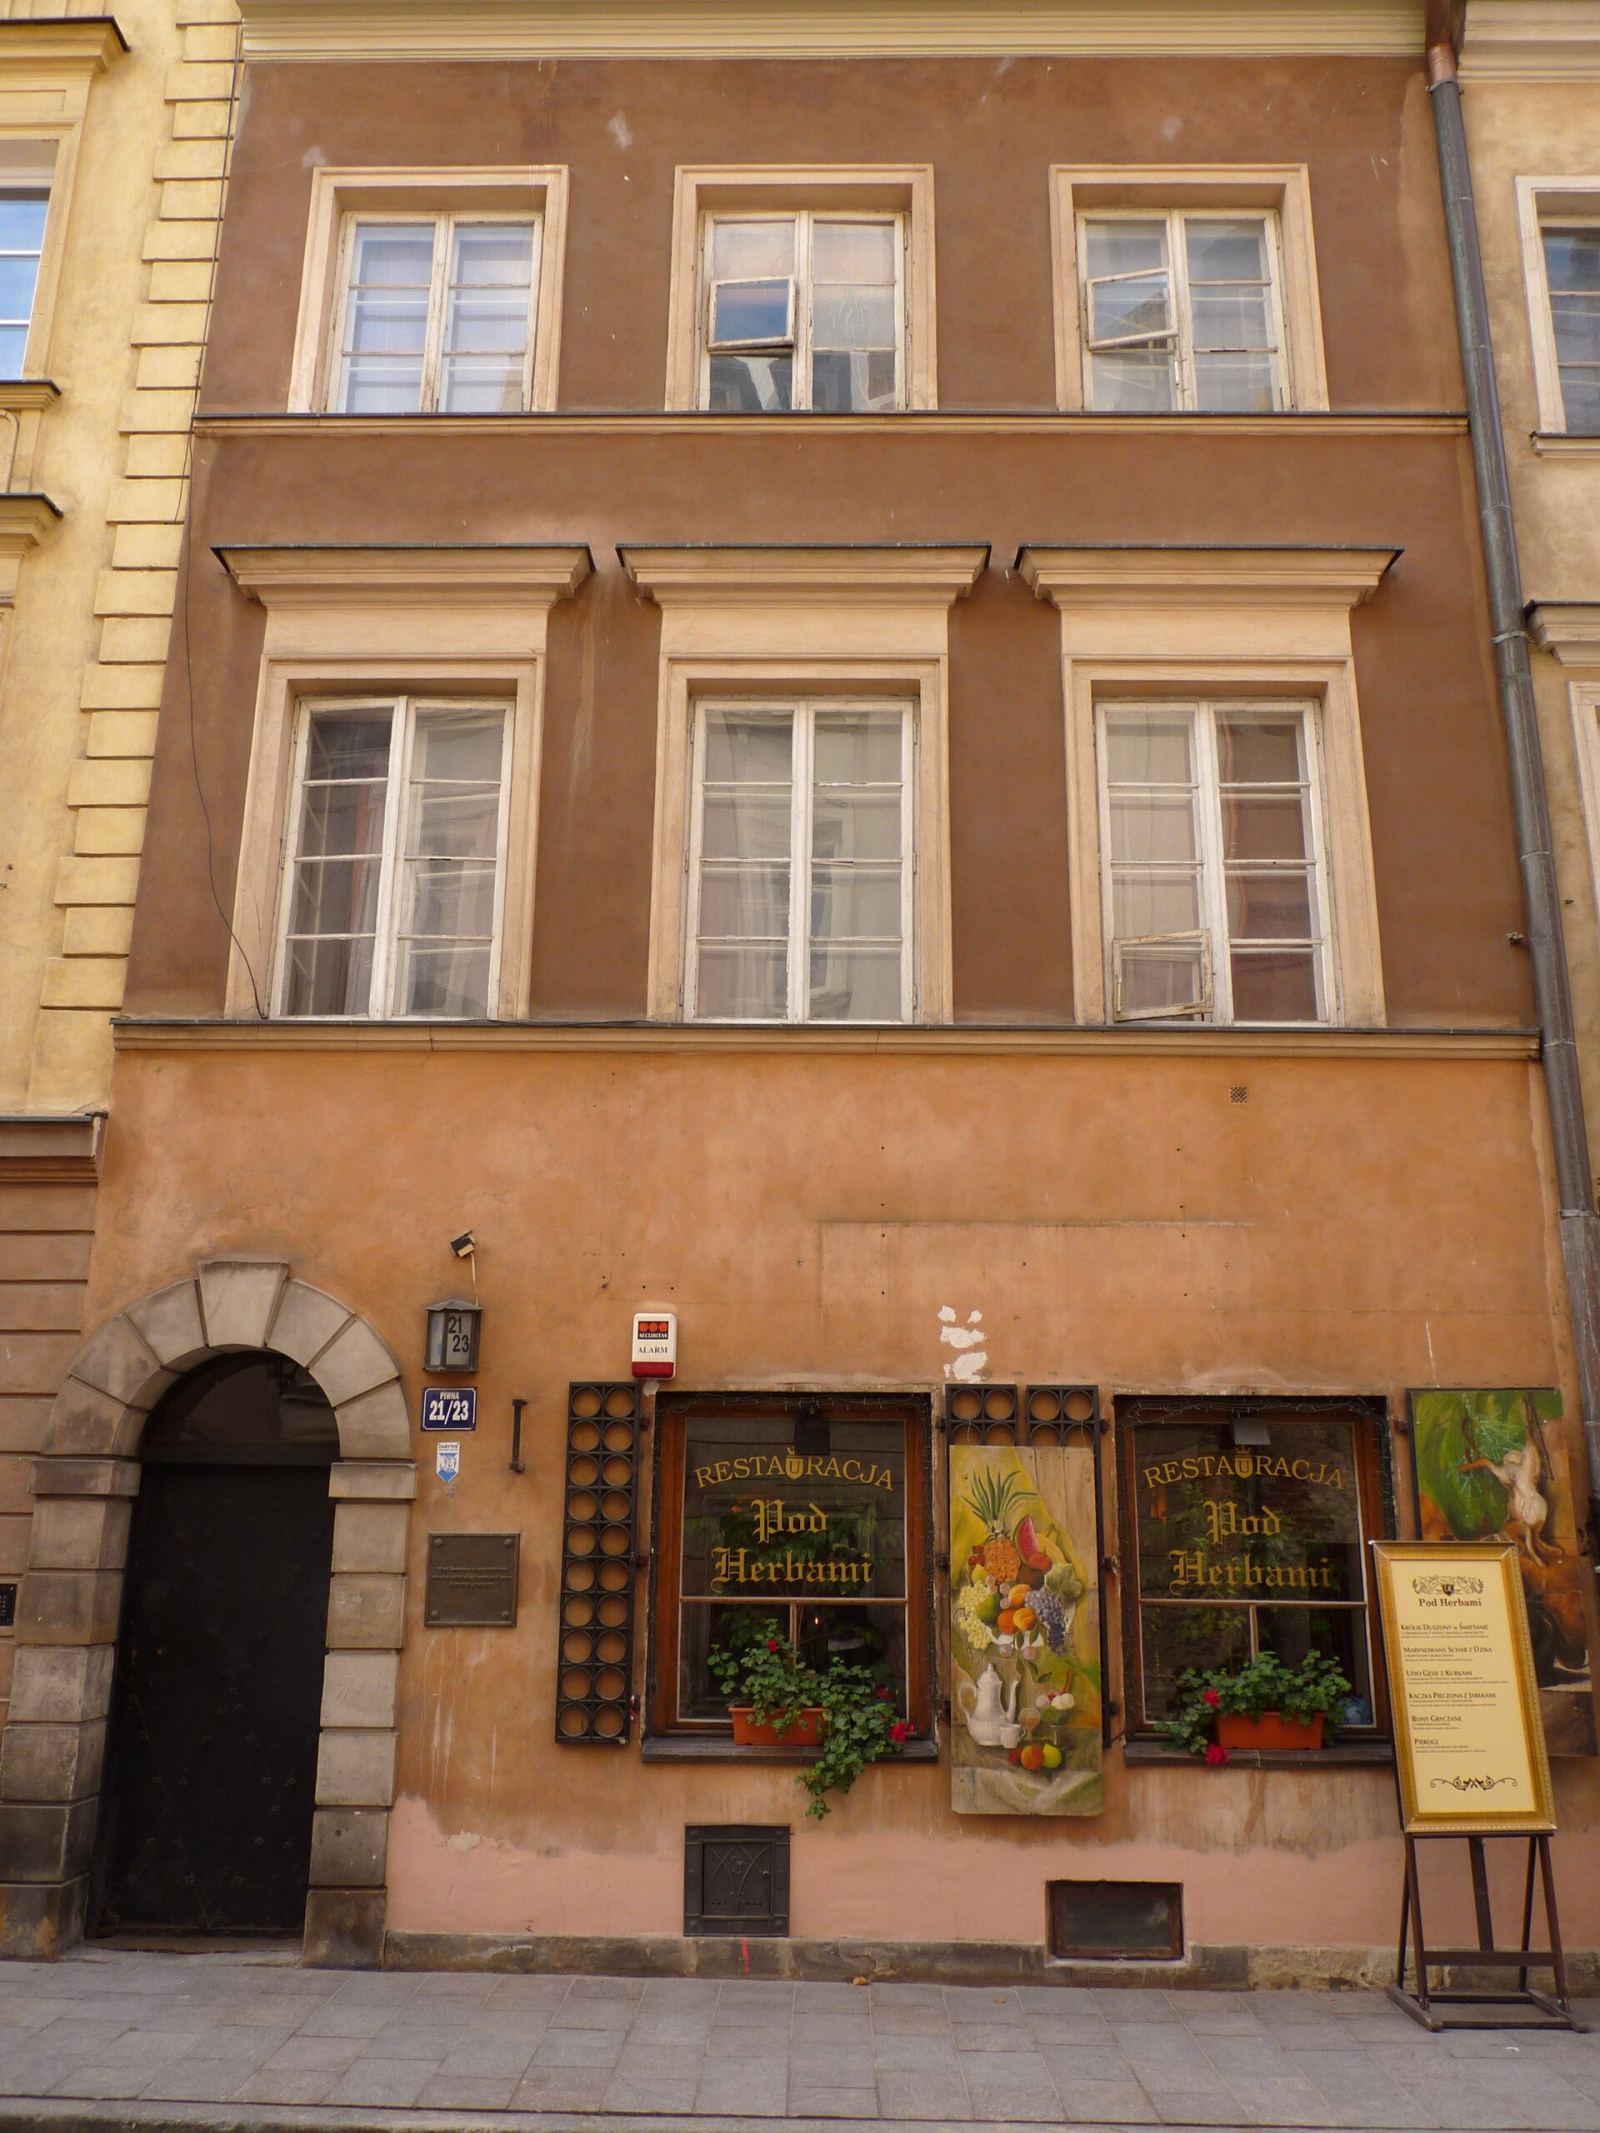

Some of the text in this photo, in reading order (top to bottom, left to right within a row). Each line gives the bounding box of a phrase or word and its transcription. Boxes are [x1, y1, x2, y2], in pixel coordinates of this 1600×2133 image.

[448, 1316, 462, 1334] 21
[452, 1335, 470, 1352] 23
[429, 1400, 469, 1425] 21/23
[440, 1392, 460, 1400] PIWNA
[693, 1454, 894, 1491] RESTAURACJA
[1143, 1454, 1345, 1490] RESTAURACJA
[751, 1499, 828, 1544] Pod
[1203, 1500, 1281, 1546] Pod
[710, 1546, 872, 1593] Herbami
[1168, 1549, 1332, 1596] Herbami
[1419, 1598, 1482, 1607] Pod Herbami
